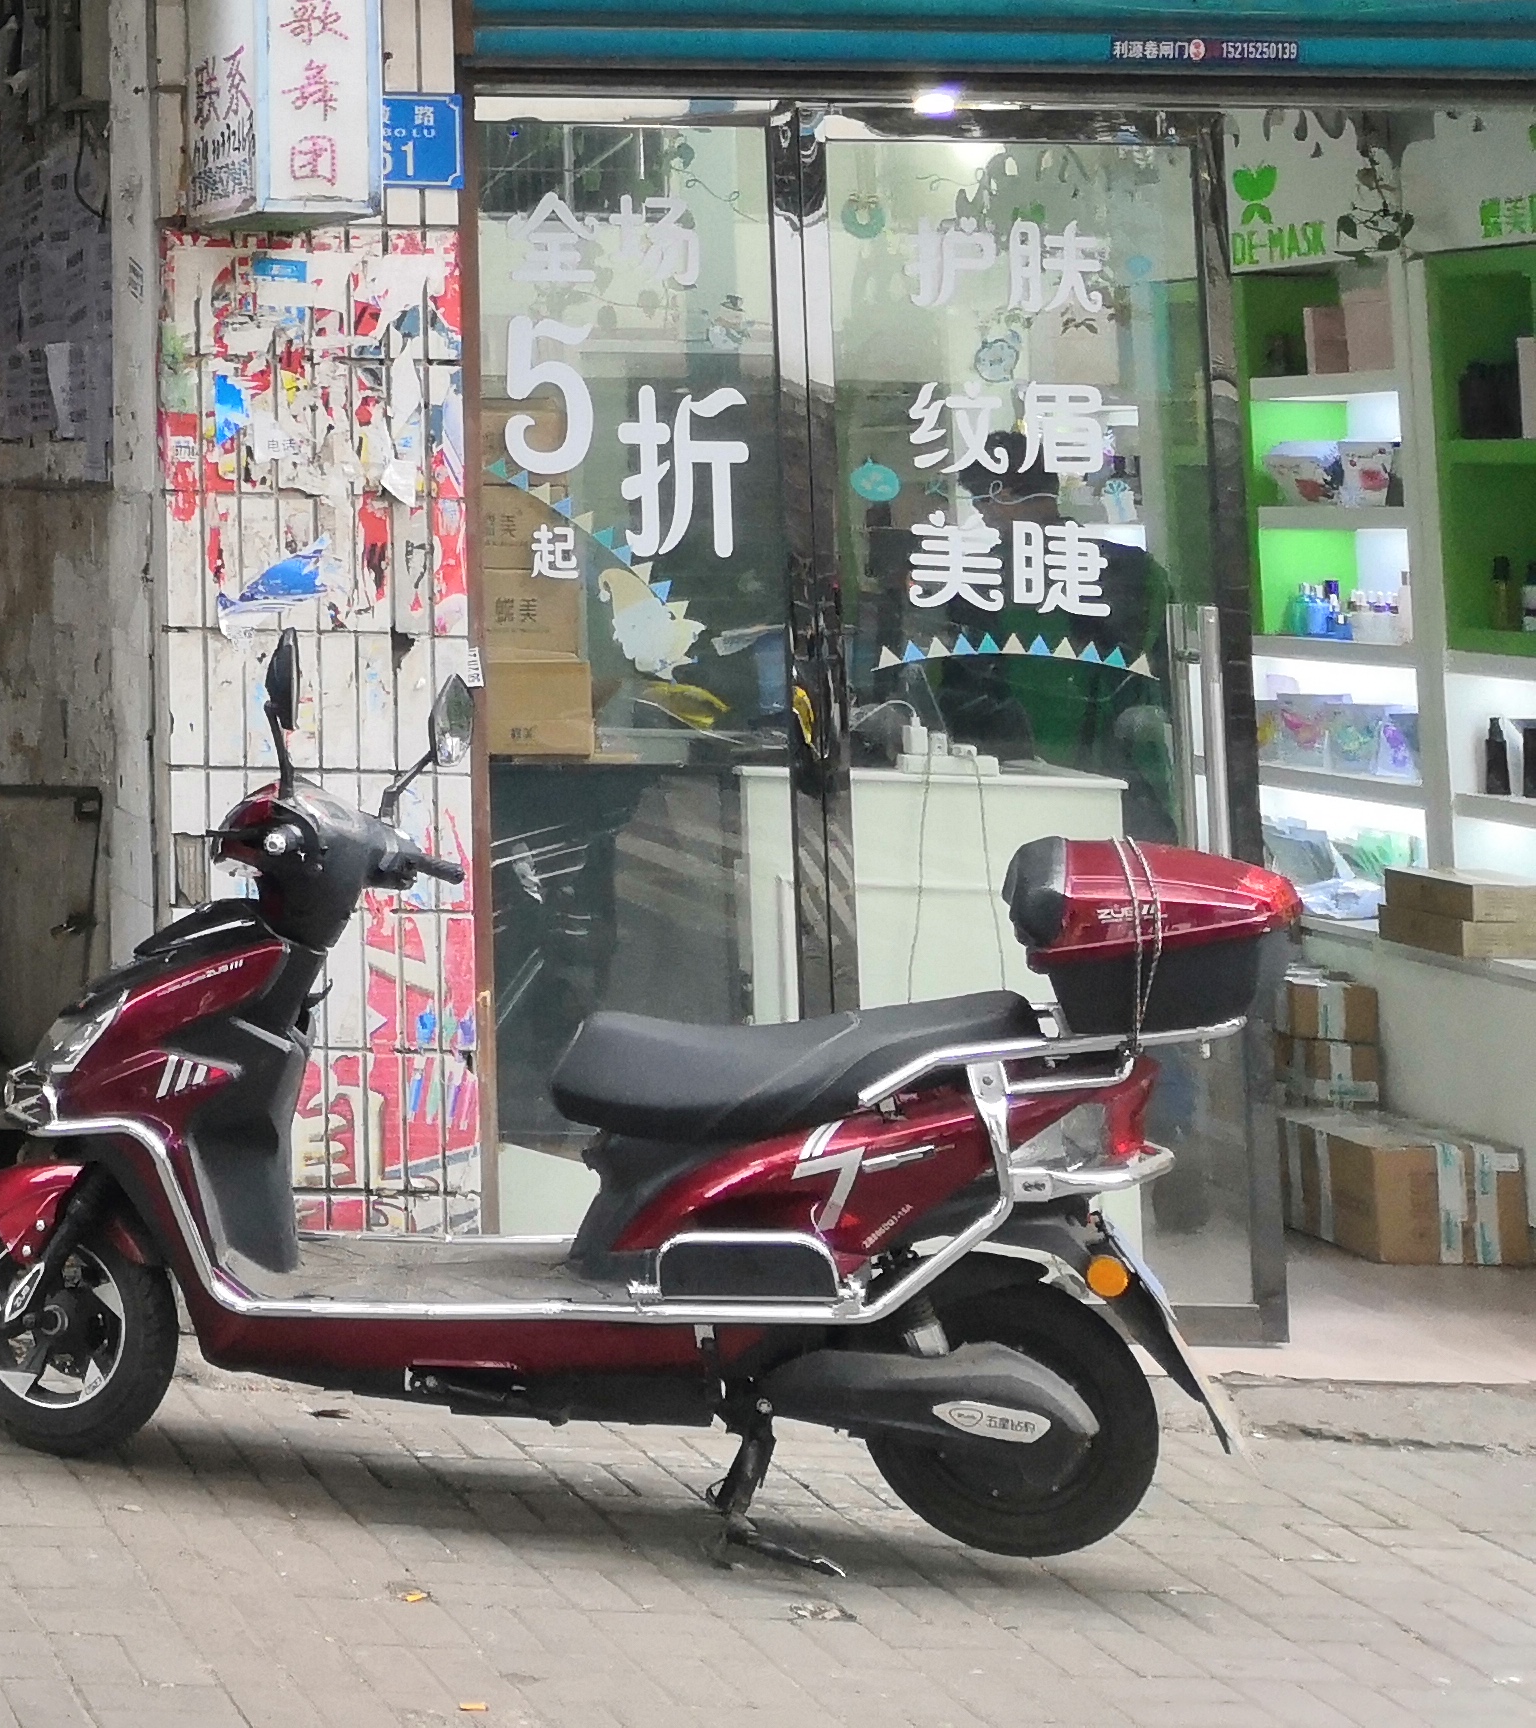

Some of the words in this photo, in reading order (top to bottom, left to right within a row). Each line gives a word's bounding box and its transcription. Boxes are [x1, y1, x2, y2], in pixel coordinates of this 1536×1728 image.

[1221, 42, 1298, 60] 15215250139
[508, 191, 700, 288] 全场
[904, 216, 1105, 314] 护肤
[909, 381, 1108, 475] 纹眉
[530, 523, 580, 580] 起
[908, 510, 1113, 618] 美睫
